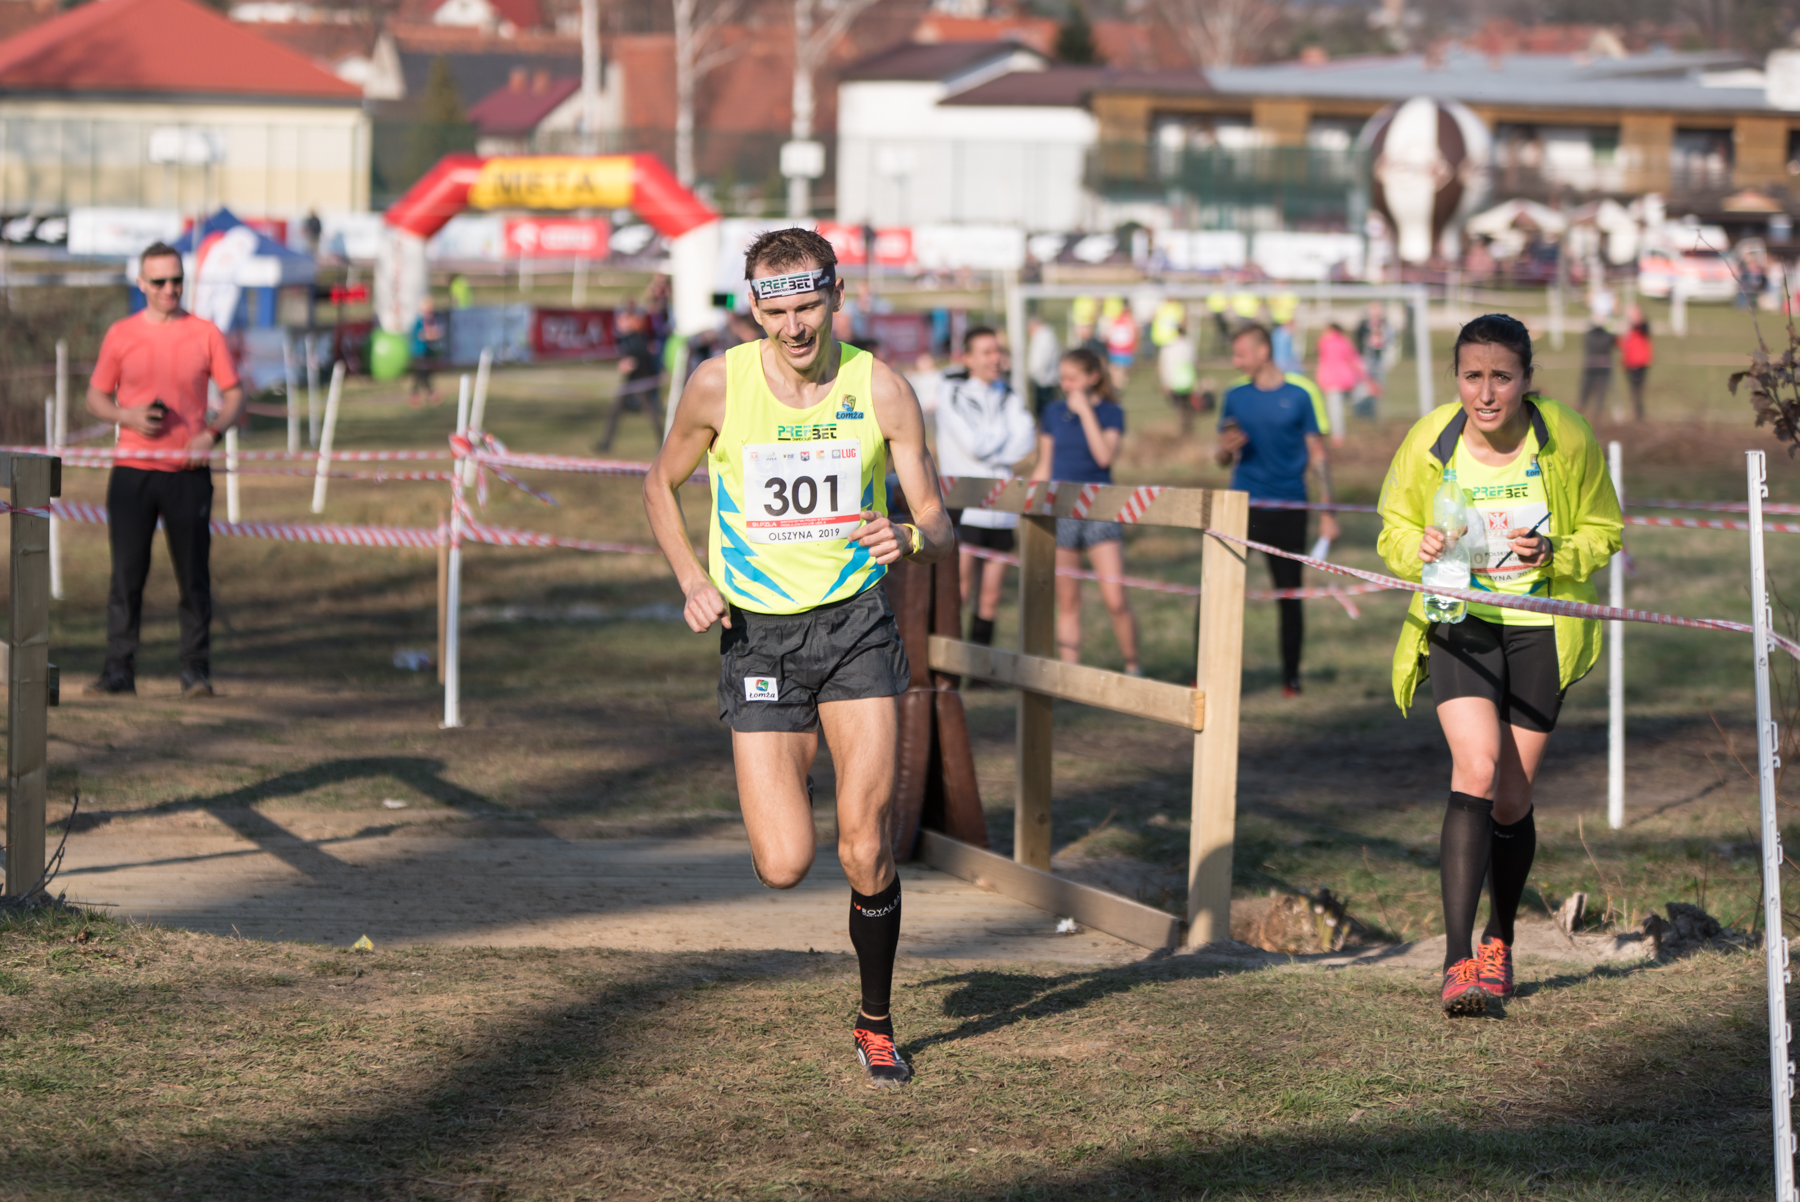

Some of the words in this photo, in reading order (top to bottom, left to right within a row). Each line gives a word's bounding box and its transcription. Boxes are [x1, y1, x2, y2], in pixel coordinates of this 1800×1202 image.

[493, 170, 597, 197] META
[841, 448, 857, 459] LUG
[763, 474, 839, 517] 301
[769, 531, 813, 541] OLSZYNA
[819, 528, 840, 538] 2019
